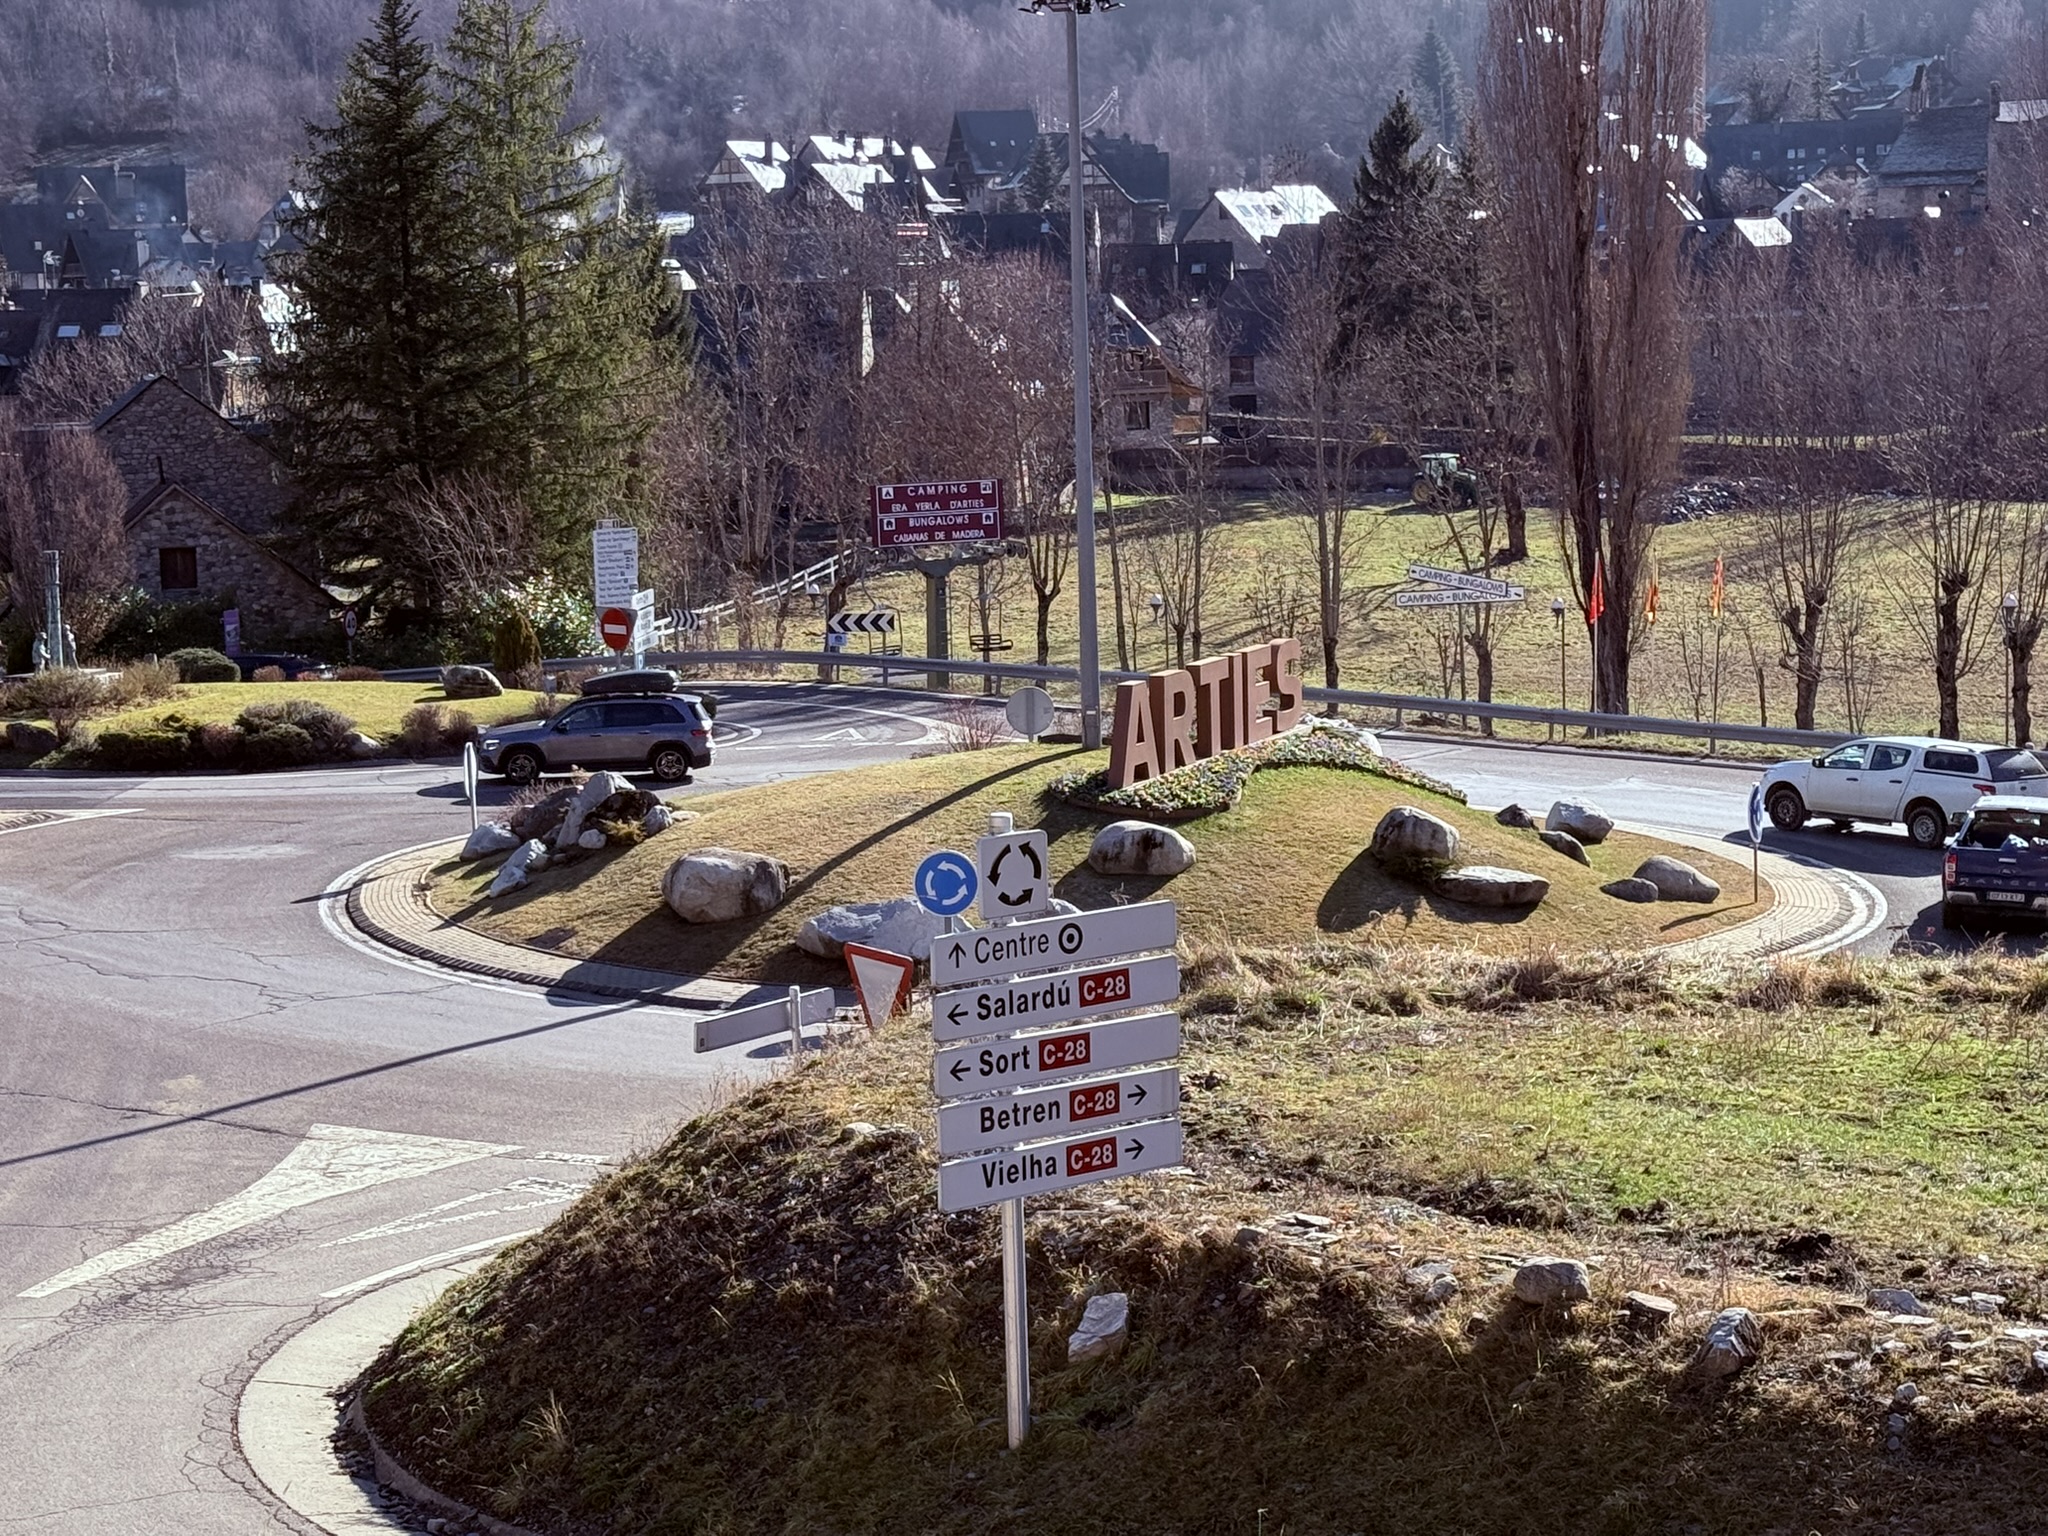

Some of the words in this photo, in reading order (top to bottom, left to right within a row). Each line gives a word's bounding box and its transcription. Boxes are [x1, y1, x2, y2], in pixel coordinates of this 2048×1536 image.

[907, 484, 968, 496] CAMPING
[891, 503, 908, 513] ERA
[915, 501, 941, 511] YERLA
[950, 498, 985, 509] D'ARTIES
[908, 514, 969, 527] BUNGALOWS
[934, 531, 946, 541] DE
[952, 529, 986, 539] MADERA
[1418, 568, 1453, 583] CAMPING
[1458, 576, 1504, 593] BUNGALOWS
[1398, 593, 1444, 604] CAMPING
[1108, 638, 1303, 788] ARTIES
[1959, 877, 2048, 887] RANGE
[974, 931, 1050, 964] Centre
[976, 979, 1071, 1021] Salardú
[1083, 974, 1127, 1002] C-28
[979, 1045, 1031, 1077] Sort
[1042, 1038, 1087, 1066] C-28
[980, 1100, 1061, 1133] Betren
[1073, 1088, 1116, 1116] C-28
[981, 1154, 1057, 1189] Vielha
[1070, 1143, 1114, 1171] C-28
